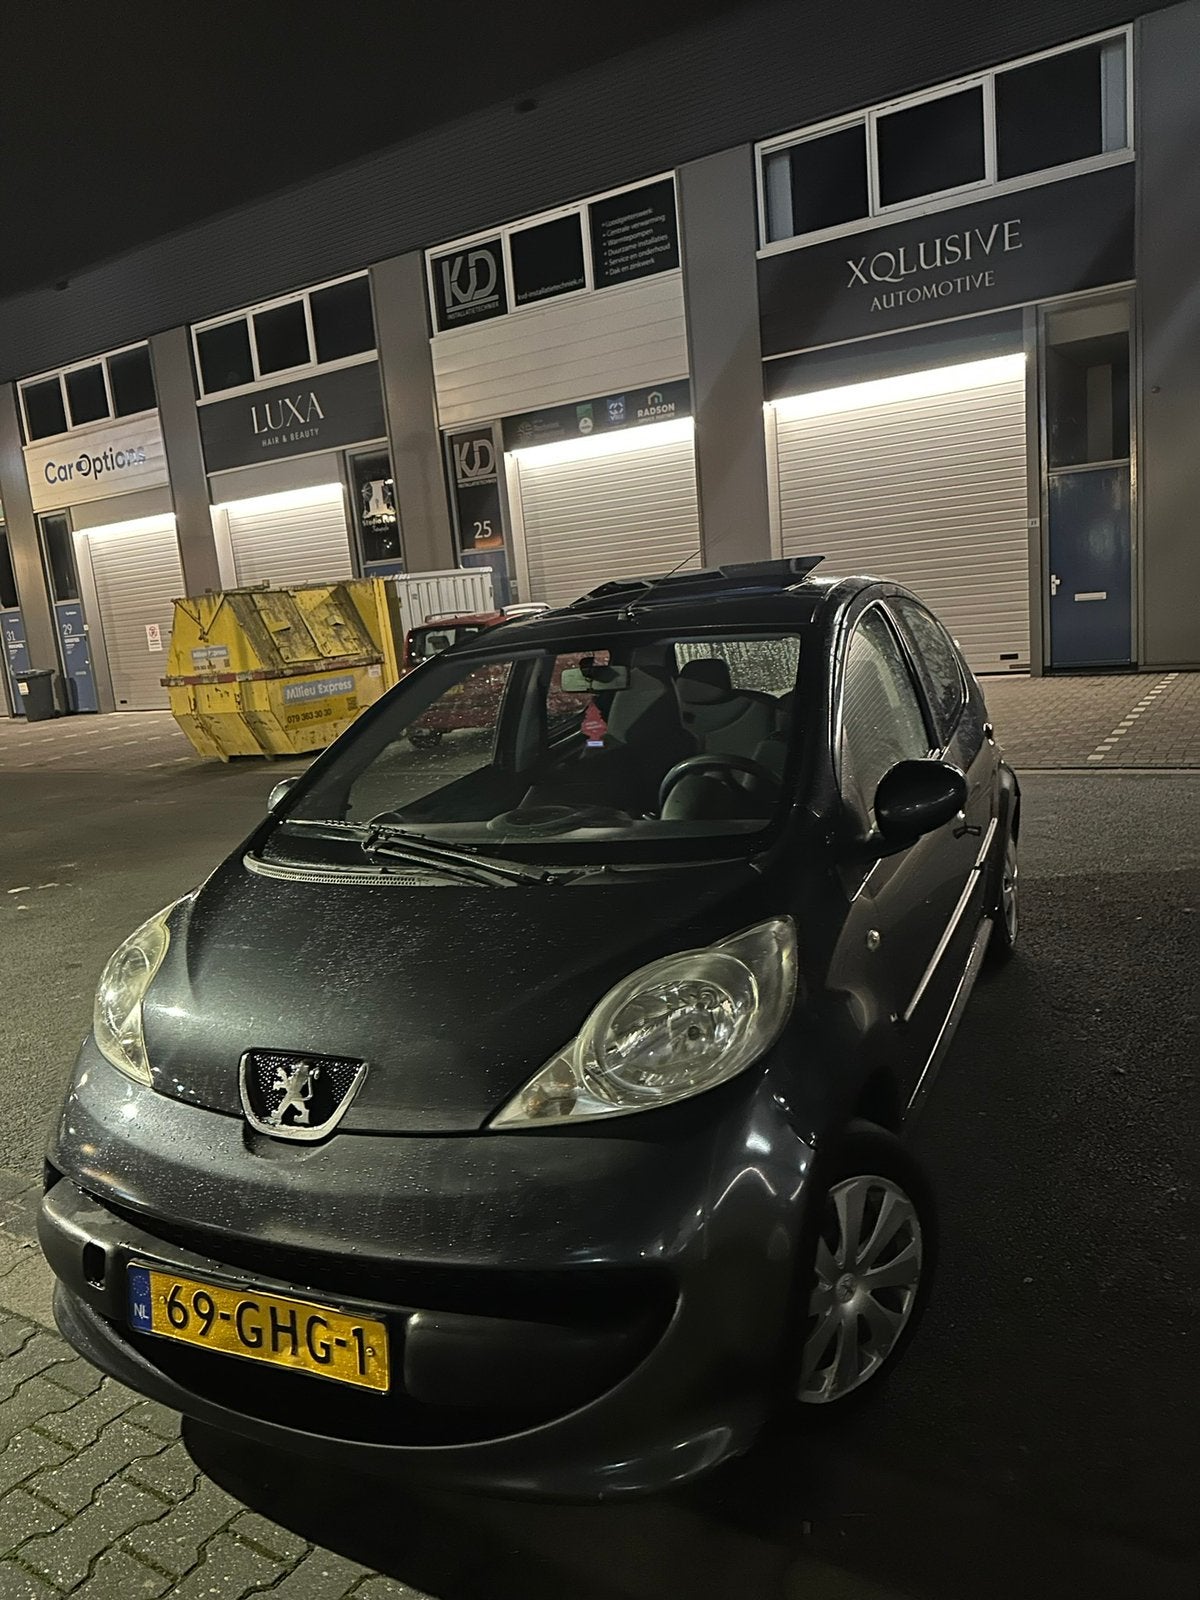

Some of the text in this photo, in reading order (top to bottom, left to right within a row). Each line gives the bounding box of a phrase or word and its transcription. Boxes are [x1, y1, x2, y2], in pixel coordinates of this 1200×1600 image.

[638, 243, 670, 257] onderhoud
[846, 219, 1024, 288] XQLUSIVE
[610, 267, 621, 275] Dak
[870, 270, 996, 312] AUTOMOTIVE
[251, 392, 325, 434] LUXA
[637, 403, 676, 418] RADSON
[262, 428, 320, 447] HAIR & BEAUTY
[473, 520, 493, 539] 25
[6, 631, 16, 642] 31
[62, 623, 73, 635] 29
[286, 680, 353, 700] Milieu Express
[287, 714, 300, 724] 079
[133, 1303, 149, 1319] NL
[166, 1284, 369, 1376] 69-GHG-1
